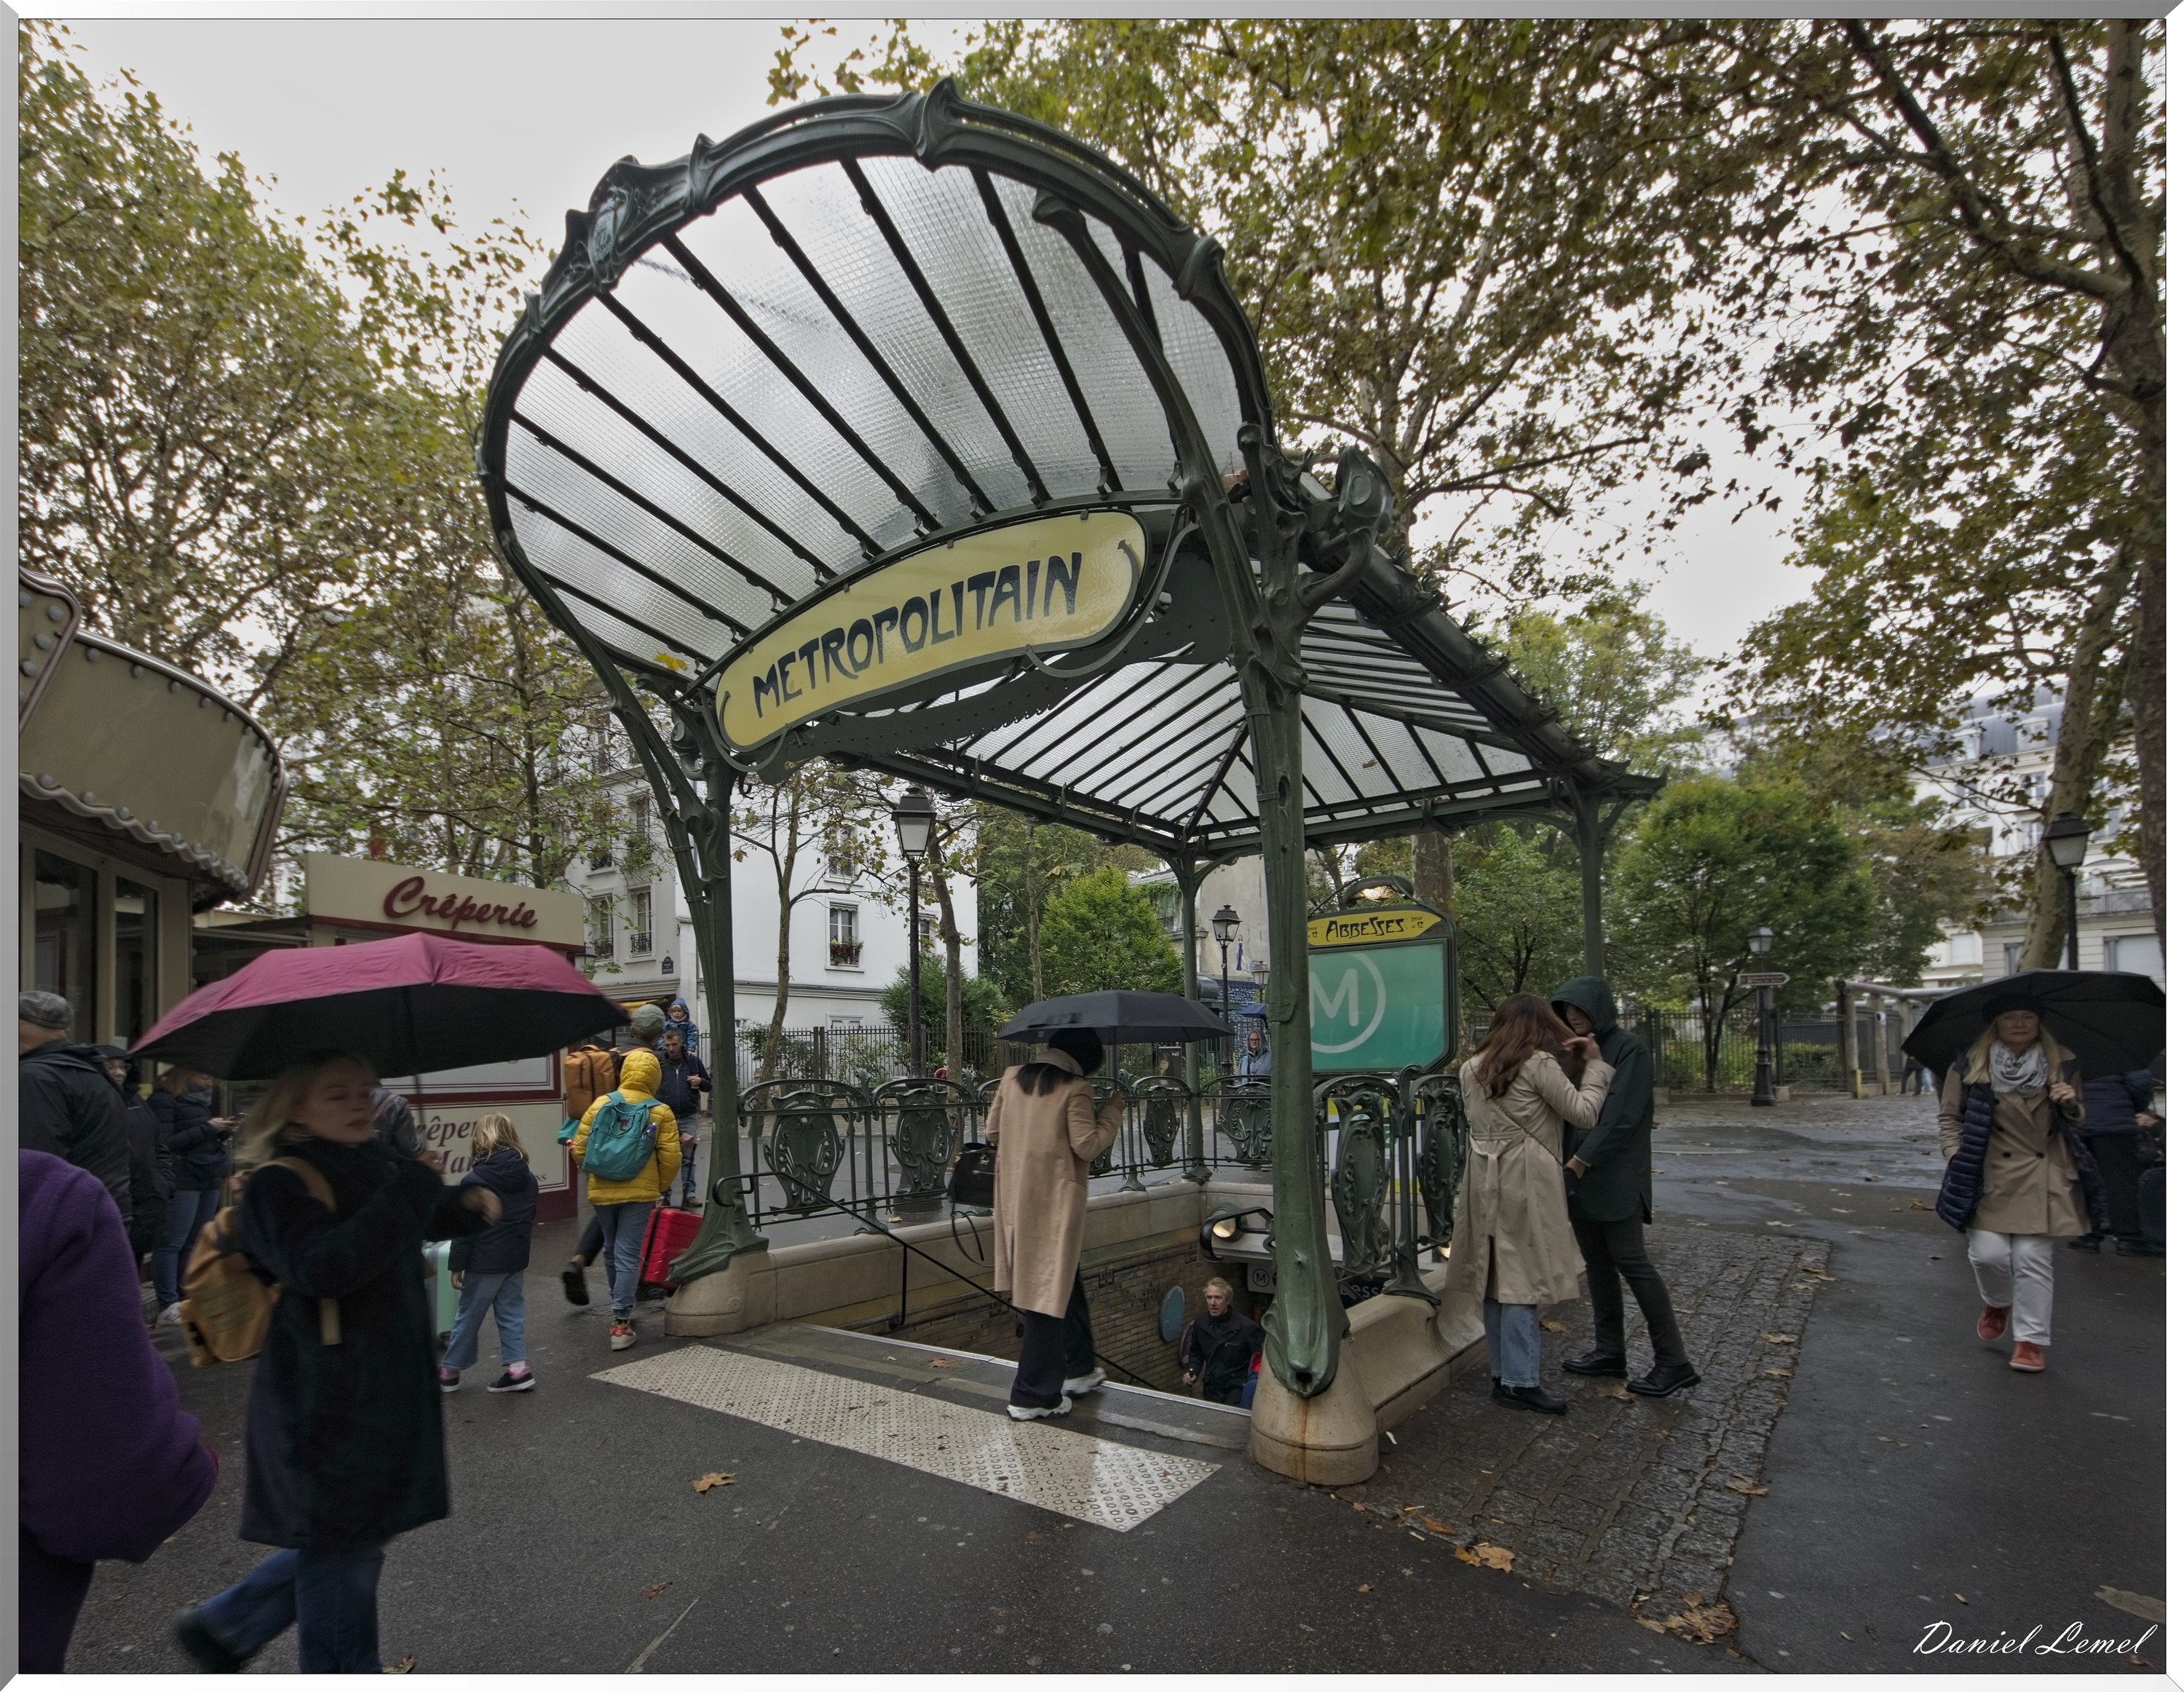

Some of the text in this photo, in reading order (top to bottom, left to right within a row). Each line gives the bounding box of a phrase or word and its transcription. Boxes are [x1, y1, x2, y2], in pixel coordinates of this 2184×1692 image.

[752, 552, 1082, 718] METROPOLITAIN
[383, 876, 538, 930] Crêperie
[1309, 968, 1359, 1029] M
